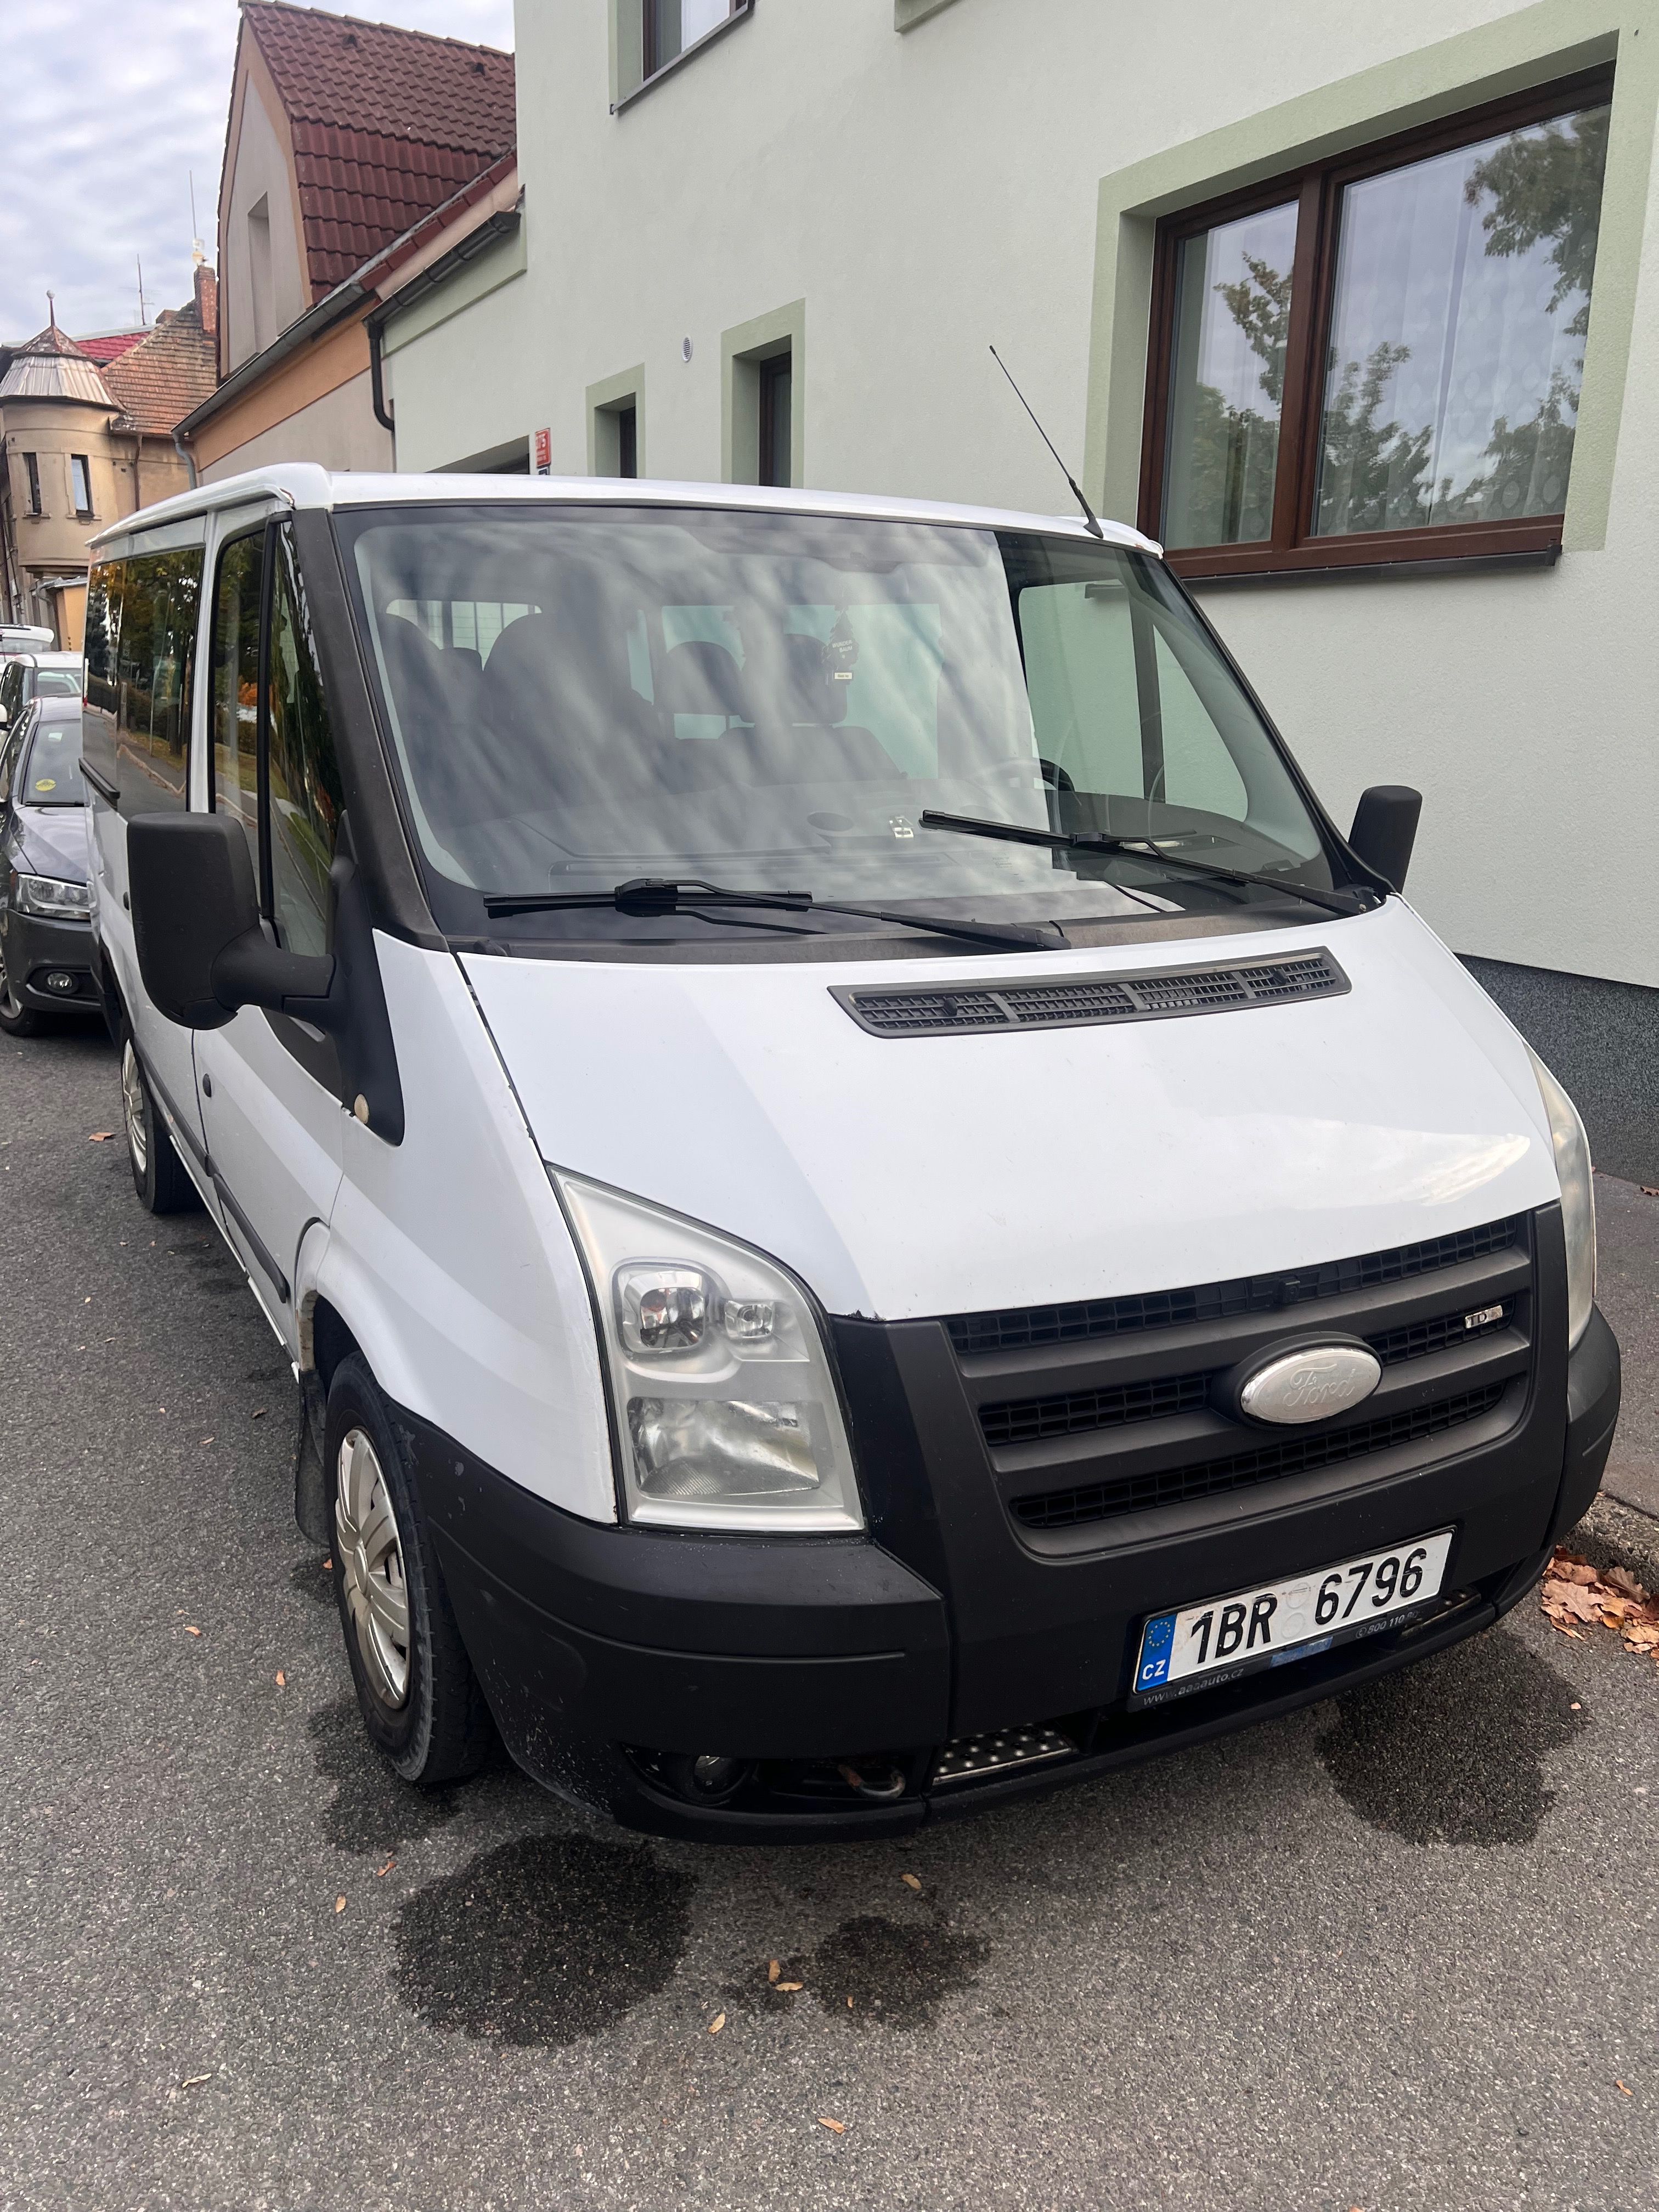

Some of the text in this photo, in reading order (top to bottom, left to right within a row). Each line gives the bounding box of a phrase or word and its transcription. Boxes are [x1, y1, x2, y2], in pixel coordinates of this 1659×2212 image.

[1283, 1363, 1356, 1407] Ford
[1190, 1548, 1428, 1664] 1BR 6796
[1389, 1614, 1405, 1628] 110
[1142, 1659, 1167, 1680] CZ
